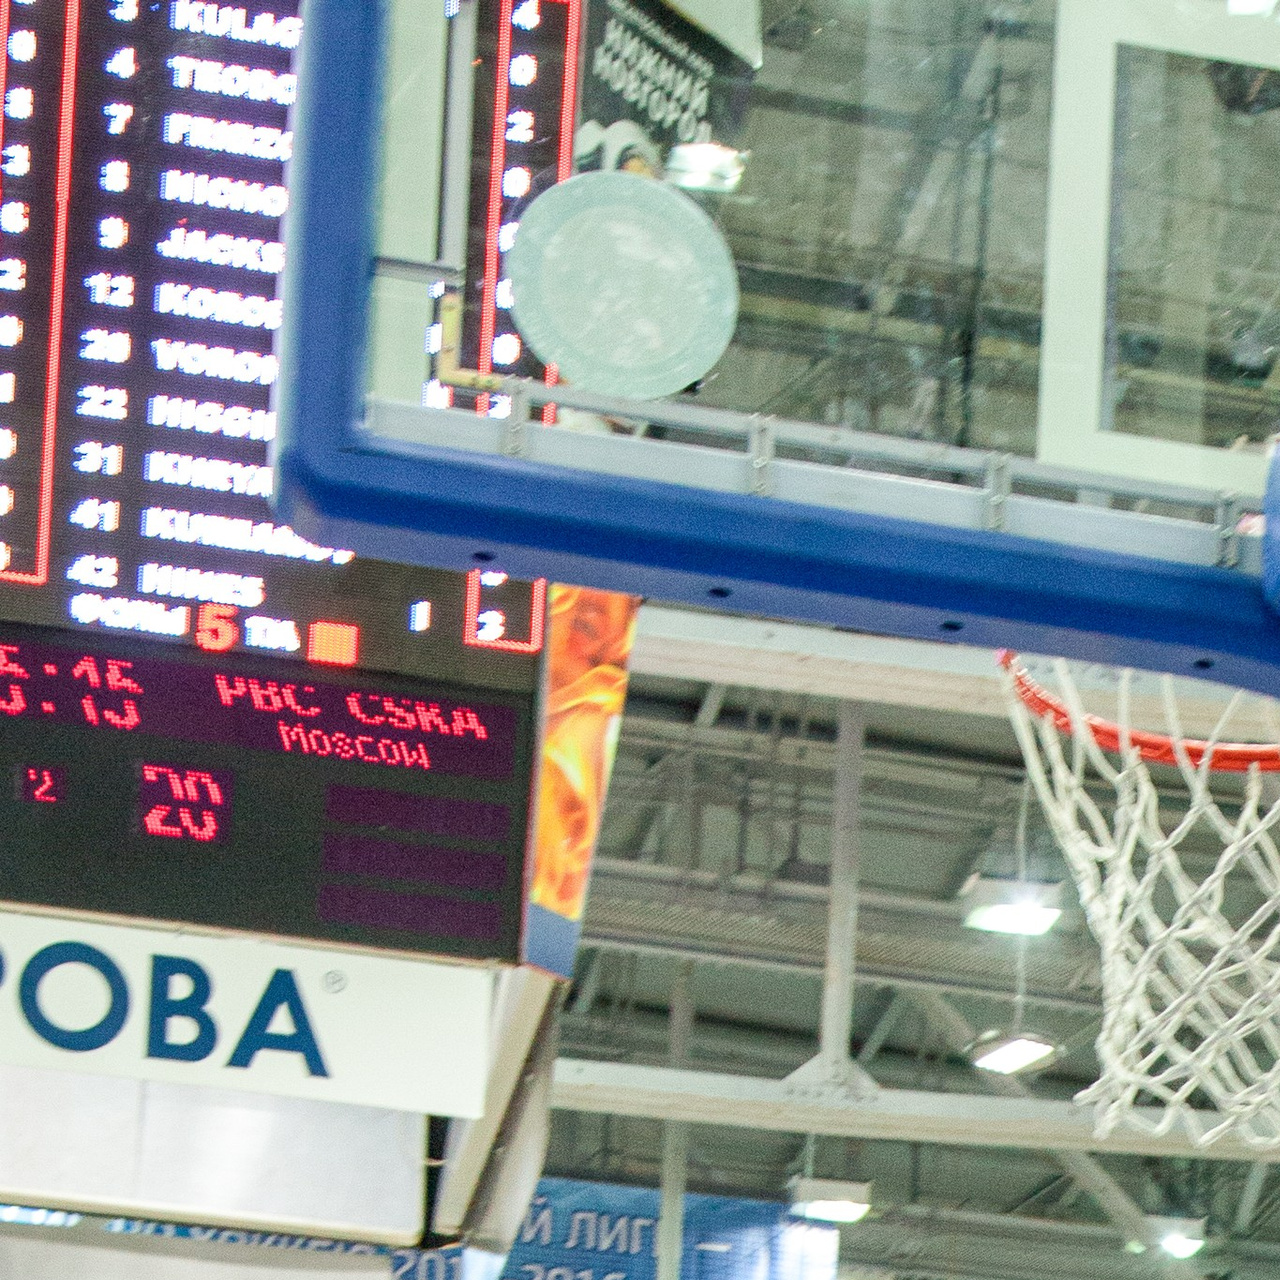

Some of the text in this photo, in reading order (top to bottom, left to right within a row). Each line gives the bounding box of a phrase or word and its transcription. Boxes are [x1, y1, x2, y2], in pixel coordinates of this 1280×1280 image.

[104, 47, 137, 80] 4
[103, 102, 134, 135] 7
[504, 109, 535, 143] 2
[83, 272, 134, 308] 12
[76, 385, 129, 420] 22
[73, 441, 123, 476] 31
[69, 498, 120, 532] 41
[66, 554, 119, 588] 42
[194, 602, 240, 652] 5
[345, 690, 489, 741] CSKA
[277, 719, 432, 770] MOSCOW
[0, 938, 331, 1080] ОВА
[561, 1210, 660, 1257] ЛИГ
